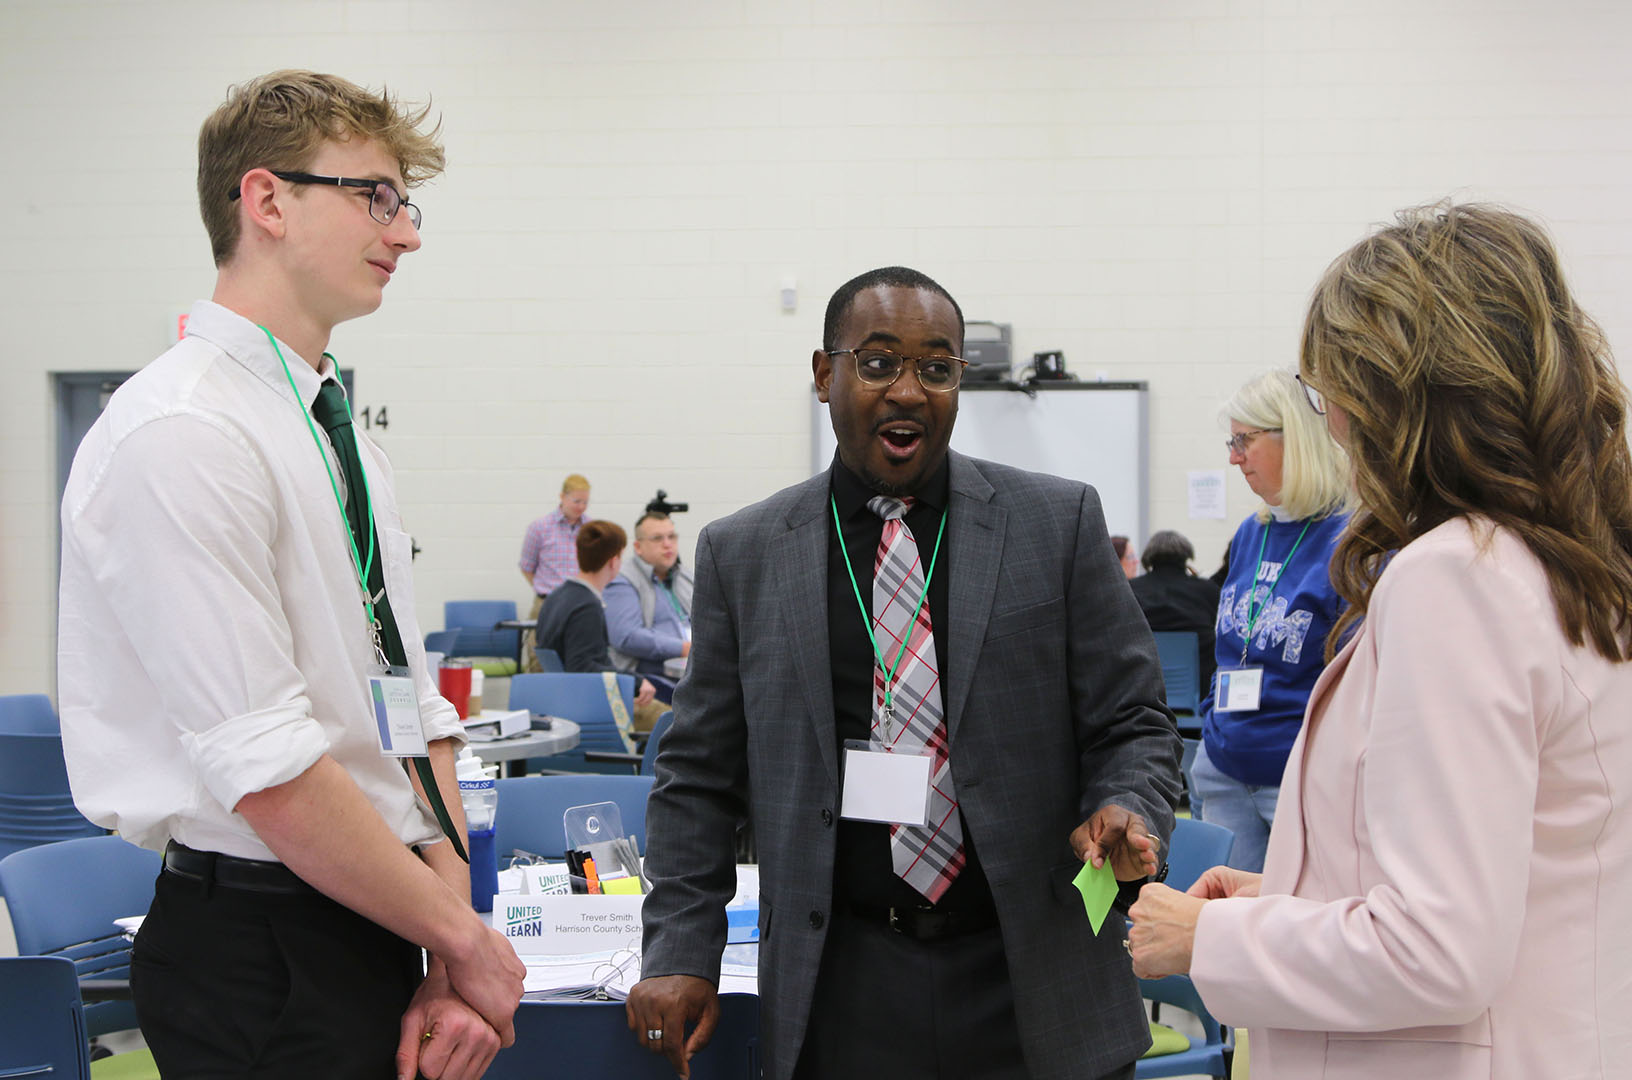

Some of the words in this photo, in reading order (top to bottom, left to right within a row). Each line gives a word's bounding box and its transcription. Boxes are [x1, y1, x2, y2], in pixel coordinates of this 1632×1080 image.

[360, 406, 389, 430] 14
[507, 906, 542, 920] UNITED
[581, 913, 607, 922] Trever
[609, 913, 634, 922] Smith
[506, 921, 542, 937] LEARN
[555, 925, 591, 933] Harrison
[592, 925, 623, 935] County
